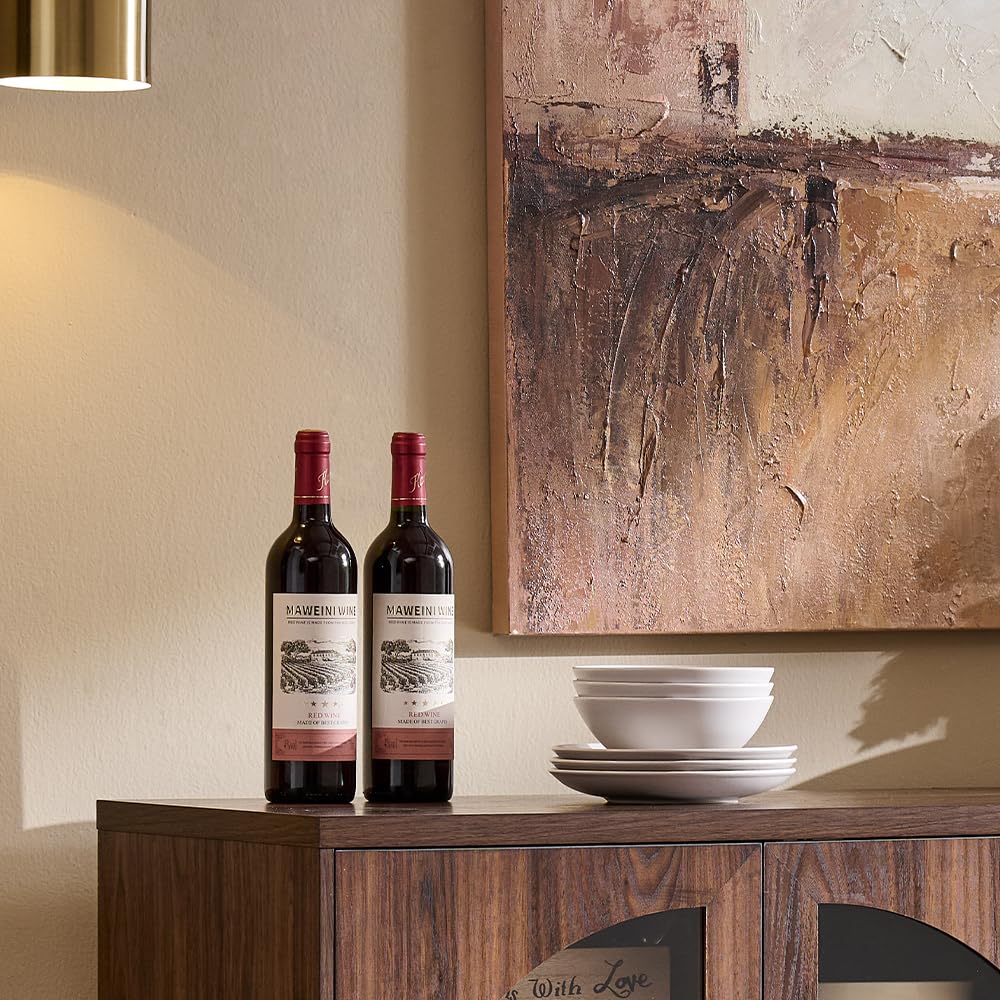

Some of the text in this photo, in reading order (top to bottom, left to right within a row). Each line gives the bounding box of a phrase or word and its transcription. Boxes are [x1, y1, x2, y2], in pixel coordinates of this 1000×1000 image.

[286, 605, 336, 616] MAWEINI
[386, 605, 436, 616] MAWEINI
[527, 975, 583, 999] With
[593, 959, 652, 999] Love
